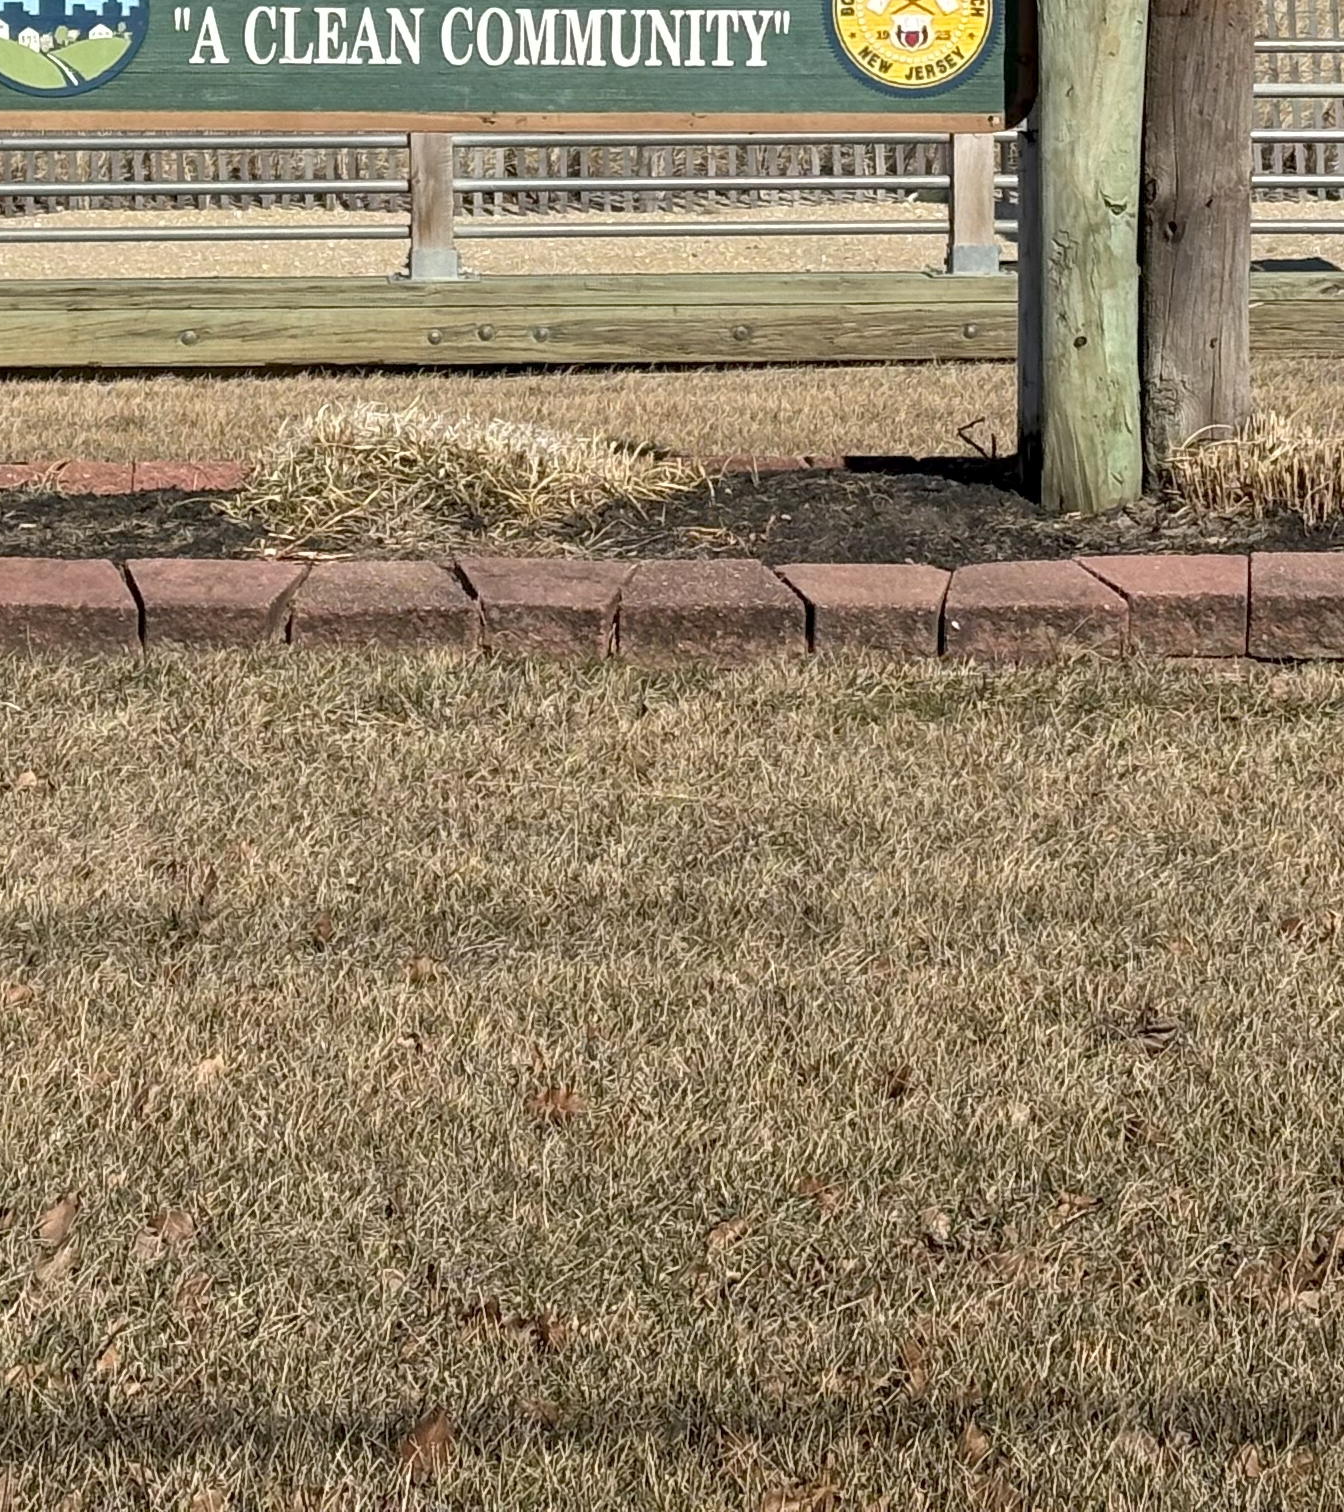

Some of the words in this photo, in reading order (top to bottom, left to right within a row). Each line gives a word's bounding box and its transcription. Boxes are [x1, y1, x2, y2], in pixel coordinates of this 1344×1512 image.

[174, 7, 229, 65] "A
[244, 6, 425, 65] CLEAN
[440, 6, 791, 68] COMMUNITY"
[858, 45, 894, 75] NEW
[905, 45, 966, 81] JERSEY
